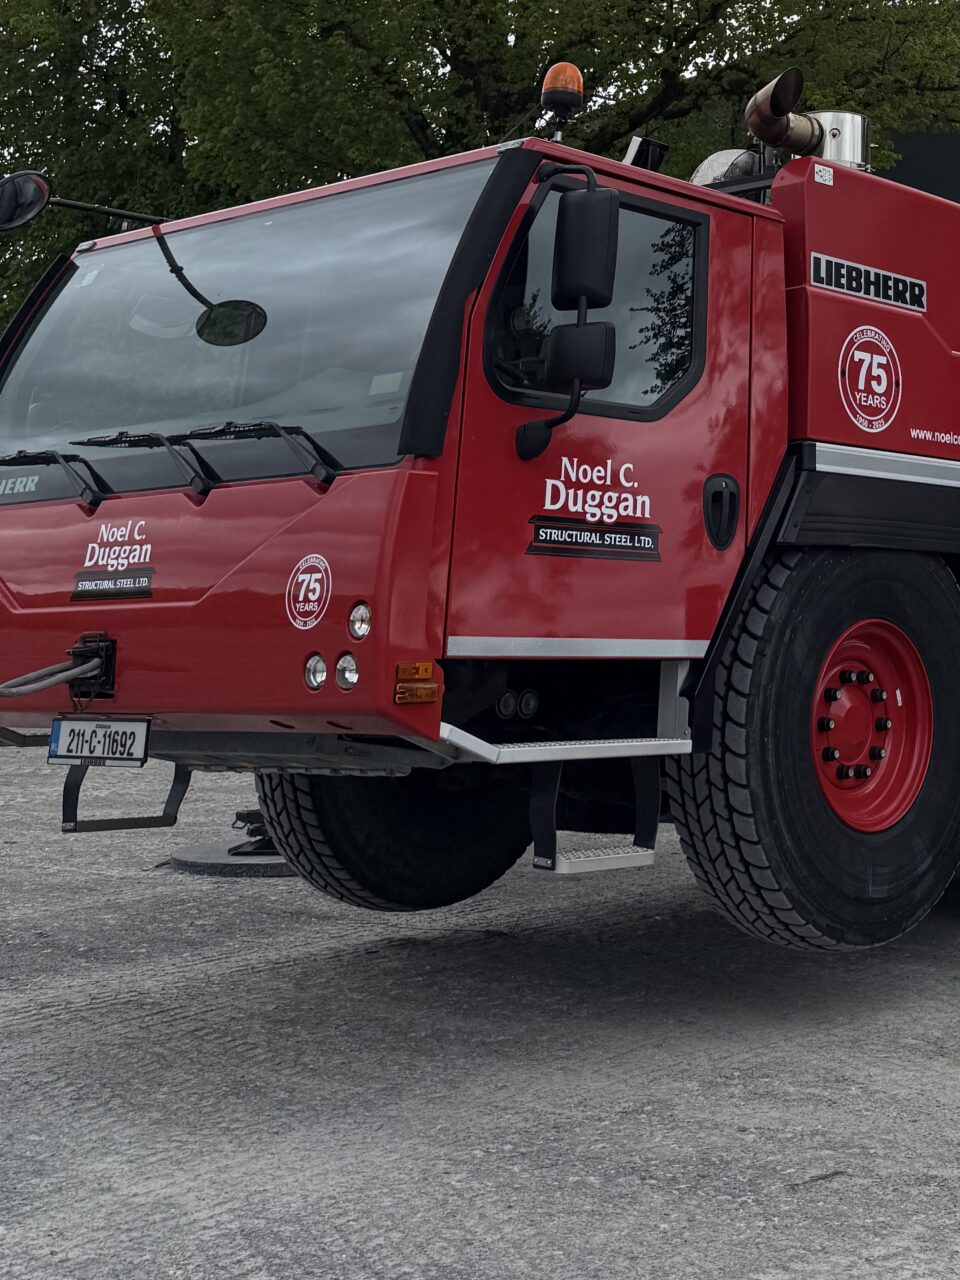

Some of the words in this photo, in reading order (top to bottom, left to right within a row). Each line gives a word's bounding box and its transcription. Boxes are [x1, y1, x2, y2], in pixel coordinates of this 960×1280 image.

[813, 256, 925, 309] LIEBHERR
[853, 329, 891, 353] CELEBRATING
[853, 350, 887, 394] 75
[855, 391, 887, 409] YEARS
[560, 456, 612, 485] Noel
[619, 463, 639, 488] C.
[543, 478, 651, 523] Duggan
[97, 520, 132, 543] Noel
[134, 521, 146, 540] C.
[539, 528, 602, 544] STRUCTURAL
[604, 533, 633, 546] STEEL
[634, 535, 654, 548] LTD.
[83, 543, 152, 571] Duggan
[78, 581, 116, 590] STRUCTURAL
[116, 579, 135, 588] STEEL
[134, 578, 149, 587] LTD.
[297, 573, 323, 602] 75
[295, 602, 318, 612] YEARS
[66, 728, 136, 756] 211-C-11692
